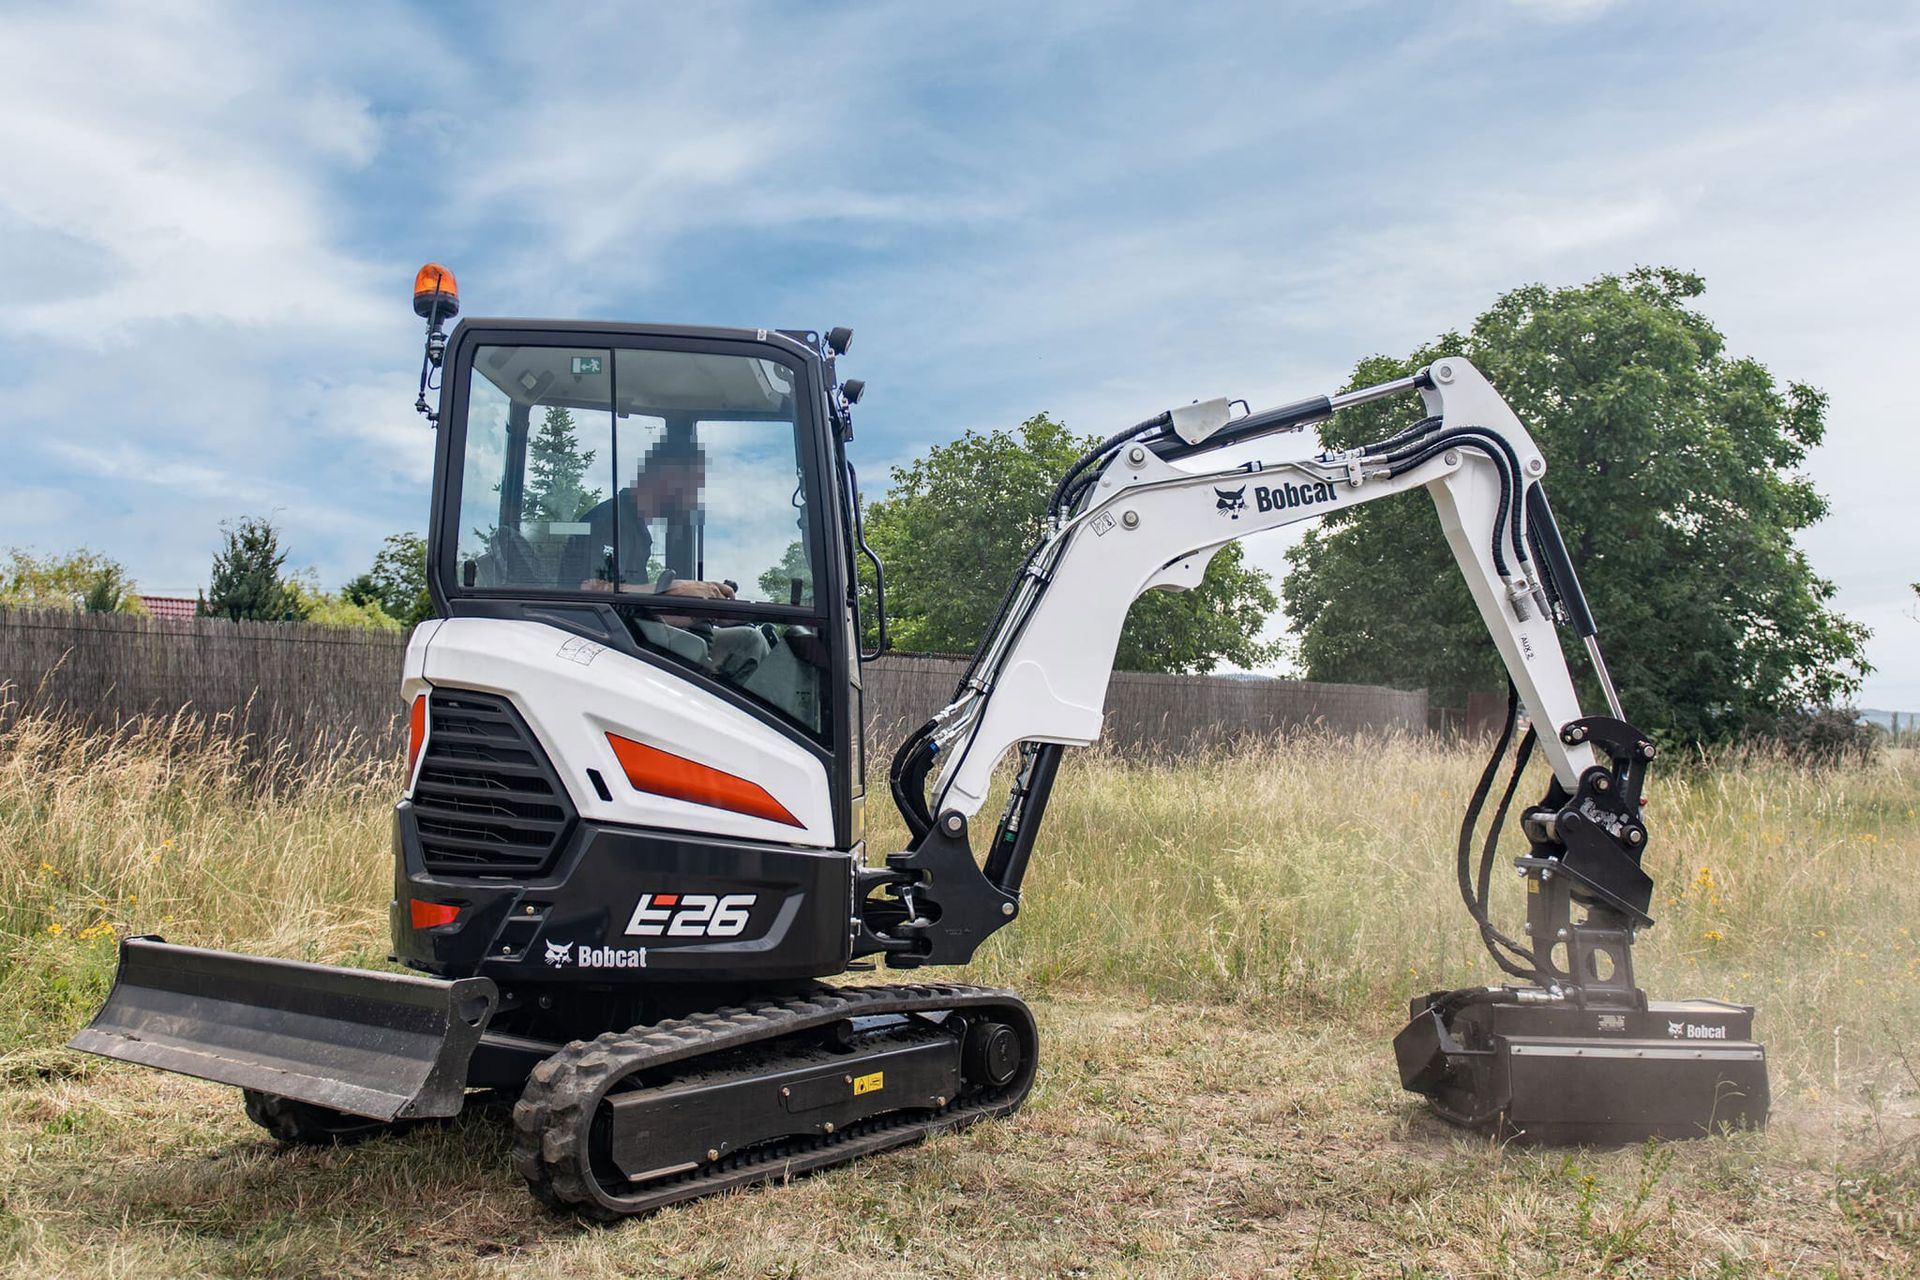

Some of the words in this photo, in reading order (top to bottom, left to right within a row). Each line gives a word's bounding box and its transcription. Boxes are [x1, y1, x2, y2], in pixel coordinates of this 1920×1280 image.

[1255, 482, 1337, 513] Bobcat
[1520, 637, 1532, 653] AUX
[624, 894, 757, 936] E26
[578, 946, 647, 968] Bobcat
[1686, 1024, 1726, 1039] Bobcat
